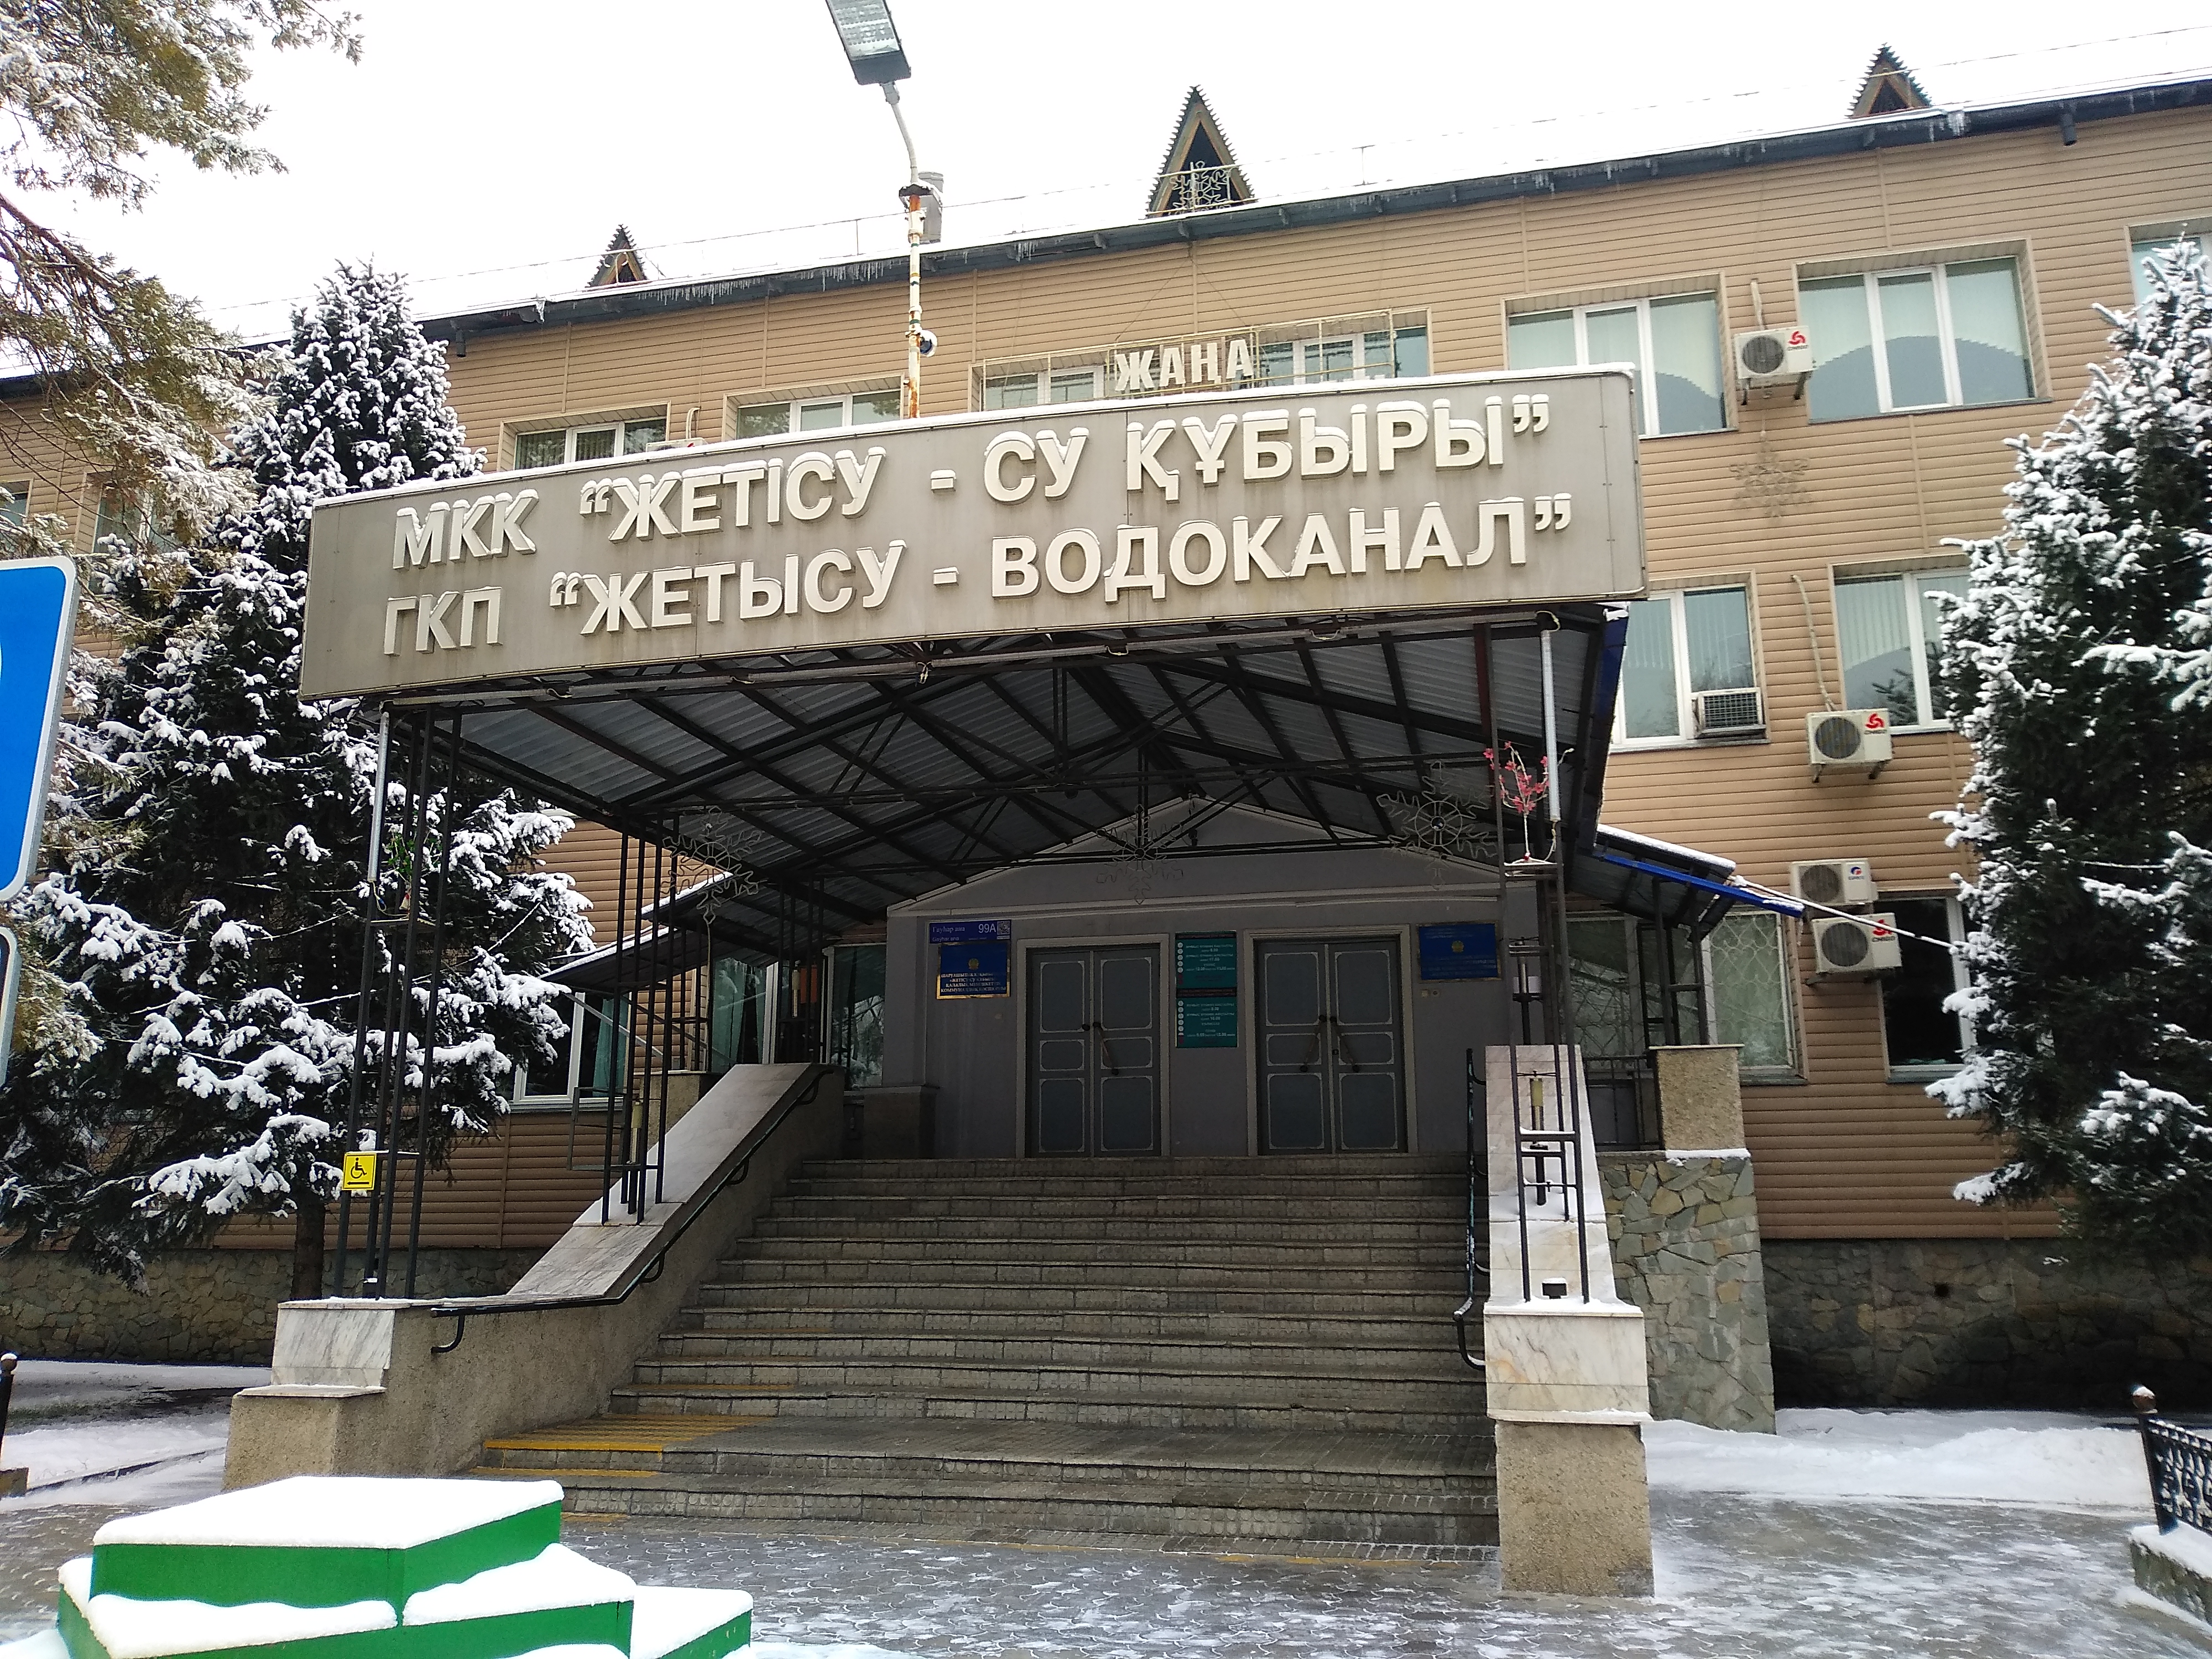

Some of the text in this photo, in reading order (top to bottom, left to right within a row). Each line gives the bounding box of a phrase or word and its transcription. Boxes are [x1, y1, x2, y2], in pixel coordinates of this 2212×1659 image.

[1115, 339, 1254, 391] ЖАҢА
[393, 492, 539, 570] МКК
[984, 430, 1089, 504] СУ
[384, 587, 503, 656] ГКП
